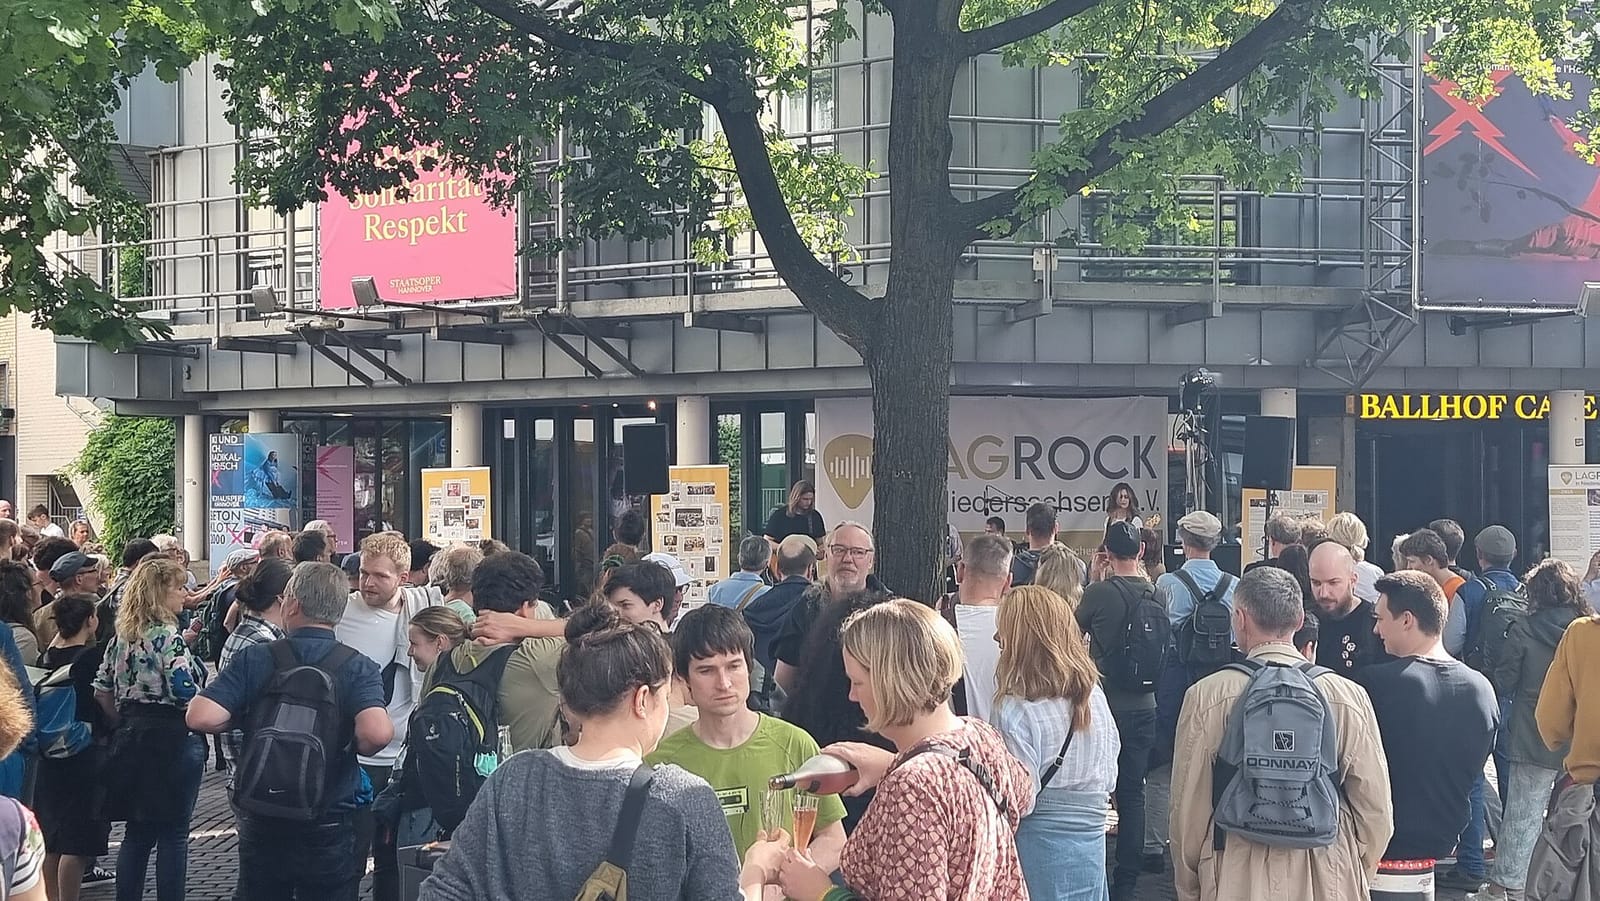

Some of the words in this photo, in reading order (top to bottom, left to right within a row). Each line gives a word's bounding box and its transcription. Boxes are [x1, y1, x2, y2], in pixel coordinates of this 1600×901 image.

[364, 206, 467, 245] Respekt
[389, 275, 441, 288] STAATSOPER
[398, 285, 433, 294] HANNOVER
[1360, 394, 1507, 419] BALLHOF
[1515, 394, 1598, 420] CAE
[947, 434, 1158, 481] AGROCK
[948, 490, 1110, 513] iedershsen
[210, 522, 240, 533] LOTZ
[1247, 758, 1316, 769] DONNAY
